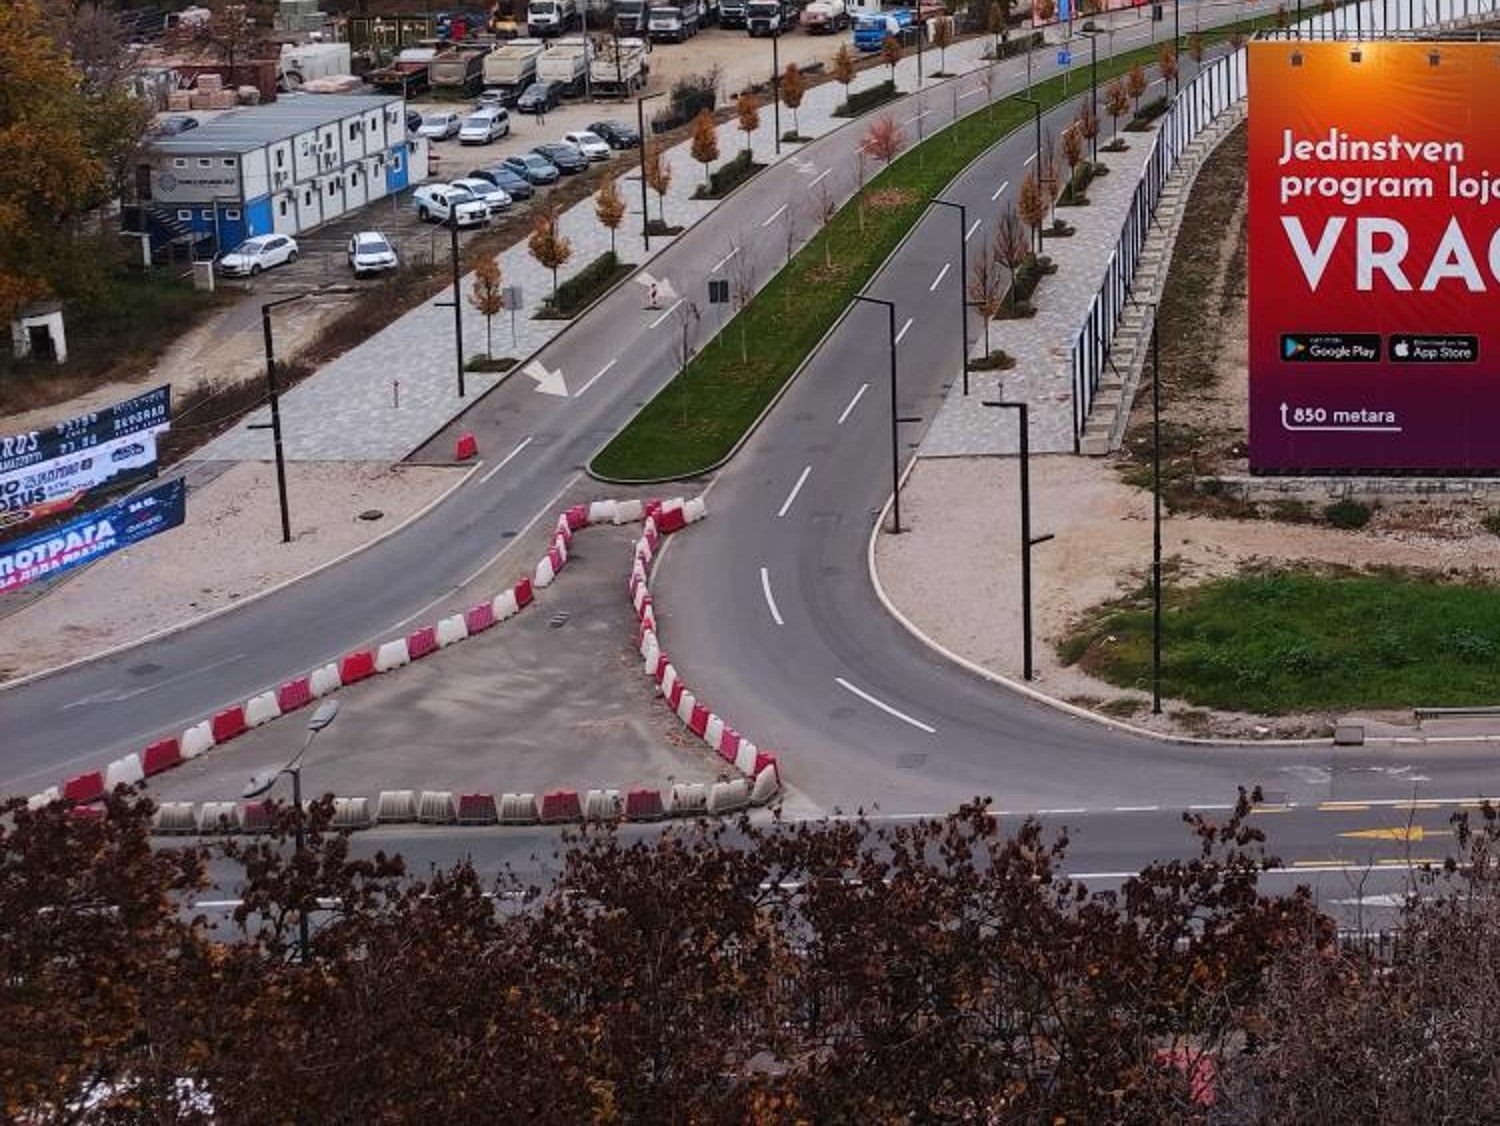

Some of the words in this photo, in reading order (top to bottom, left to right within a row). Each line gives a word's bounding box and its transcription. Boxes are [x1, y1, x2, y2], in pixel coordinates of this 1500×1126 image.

[1279, 128, 1464, 165] Jedinstven
[1280, 175, 1433, 204] program
[1309, 344, 1351, 359] Google
[1352, 345, 1376, 359] Play
[1413, 347, 1438, 359] App
[1439, 347, 1472, 359] Store
[1293, 407, 1327, 423] 850
[1333, 408, 1395, 423] metara
[0, 431, 38, 459] ROS
